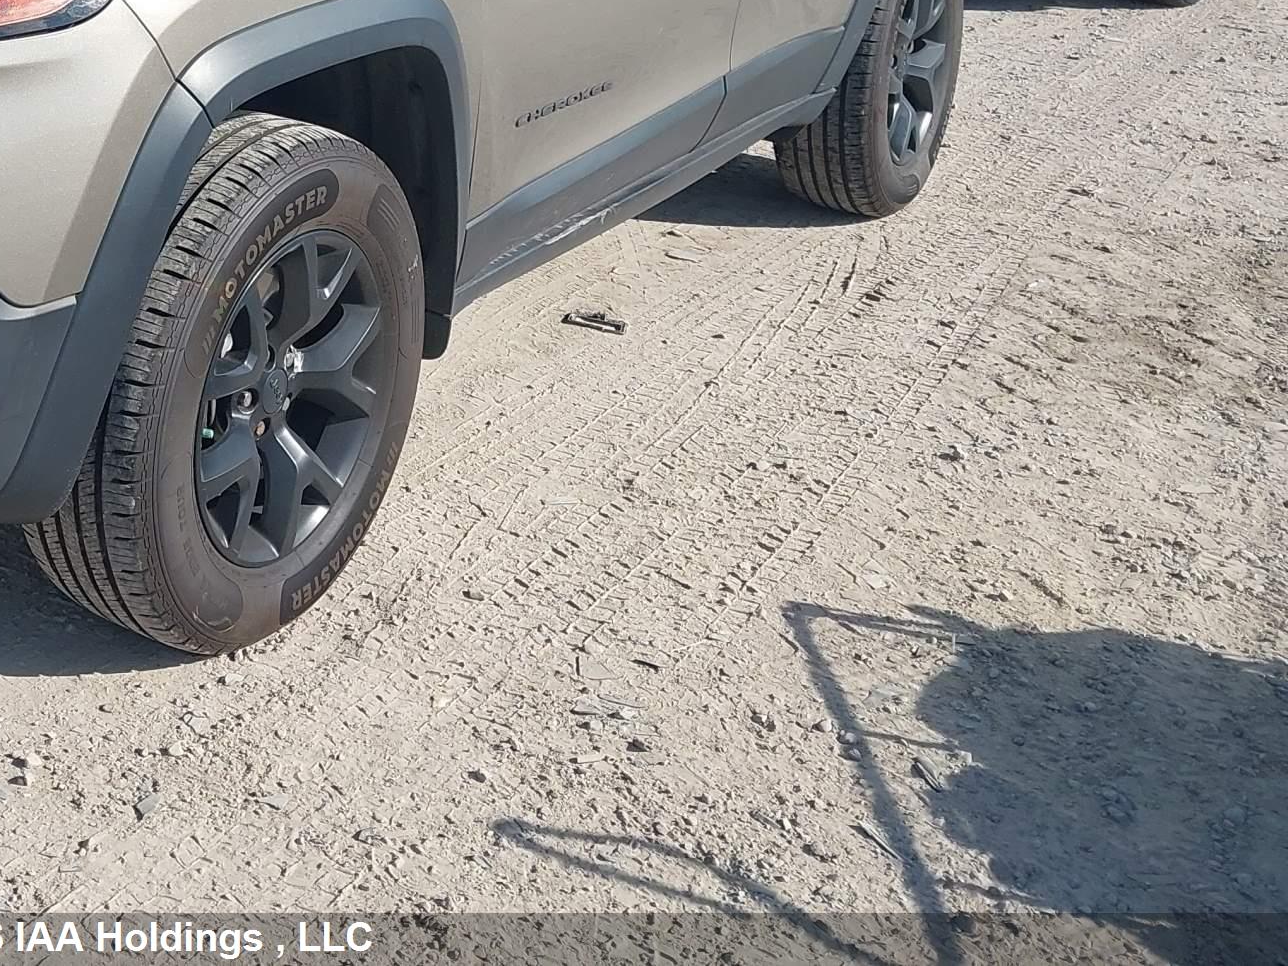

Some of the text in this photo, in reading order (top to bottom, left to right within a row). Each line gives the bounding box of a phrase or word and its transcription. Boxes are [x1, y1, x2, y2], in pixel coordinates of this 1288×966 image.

[515, 81, 613, 128] CHEROKEE
[212, 185, 328, 324] MOTOMASTER
[292, 467, 391, 611] MOTOMASTER
